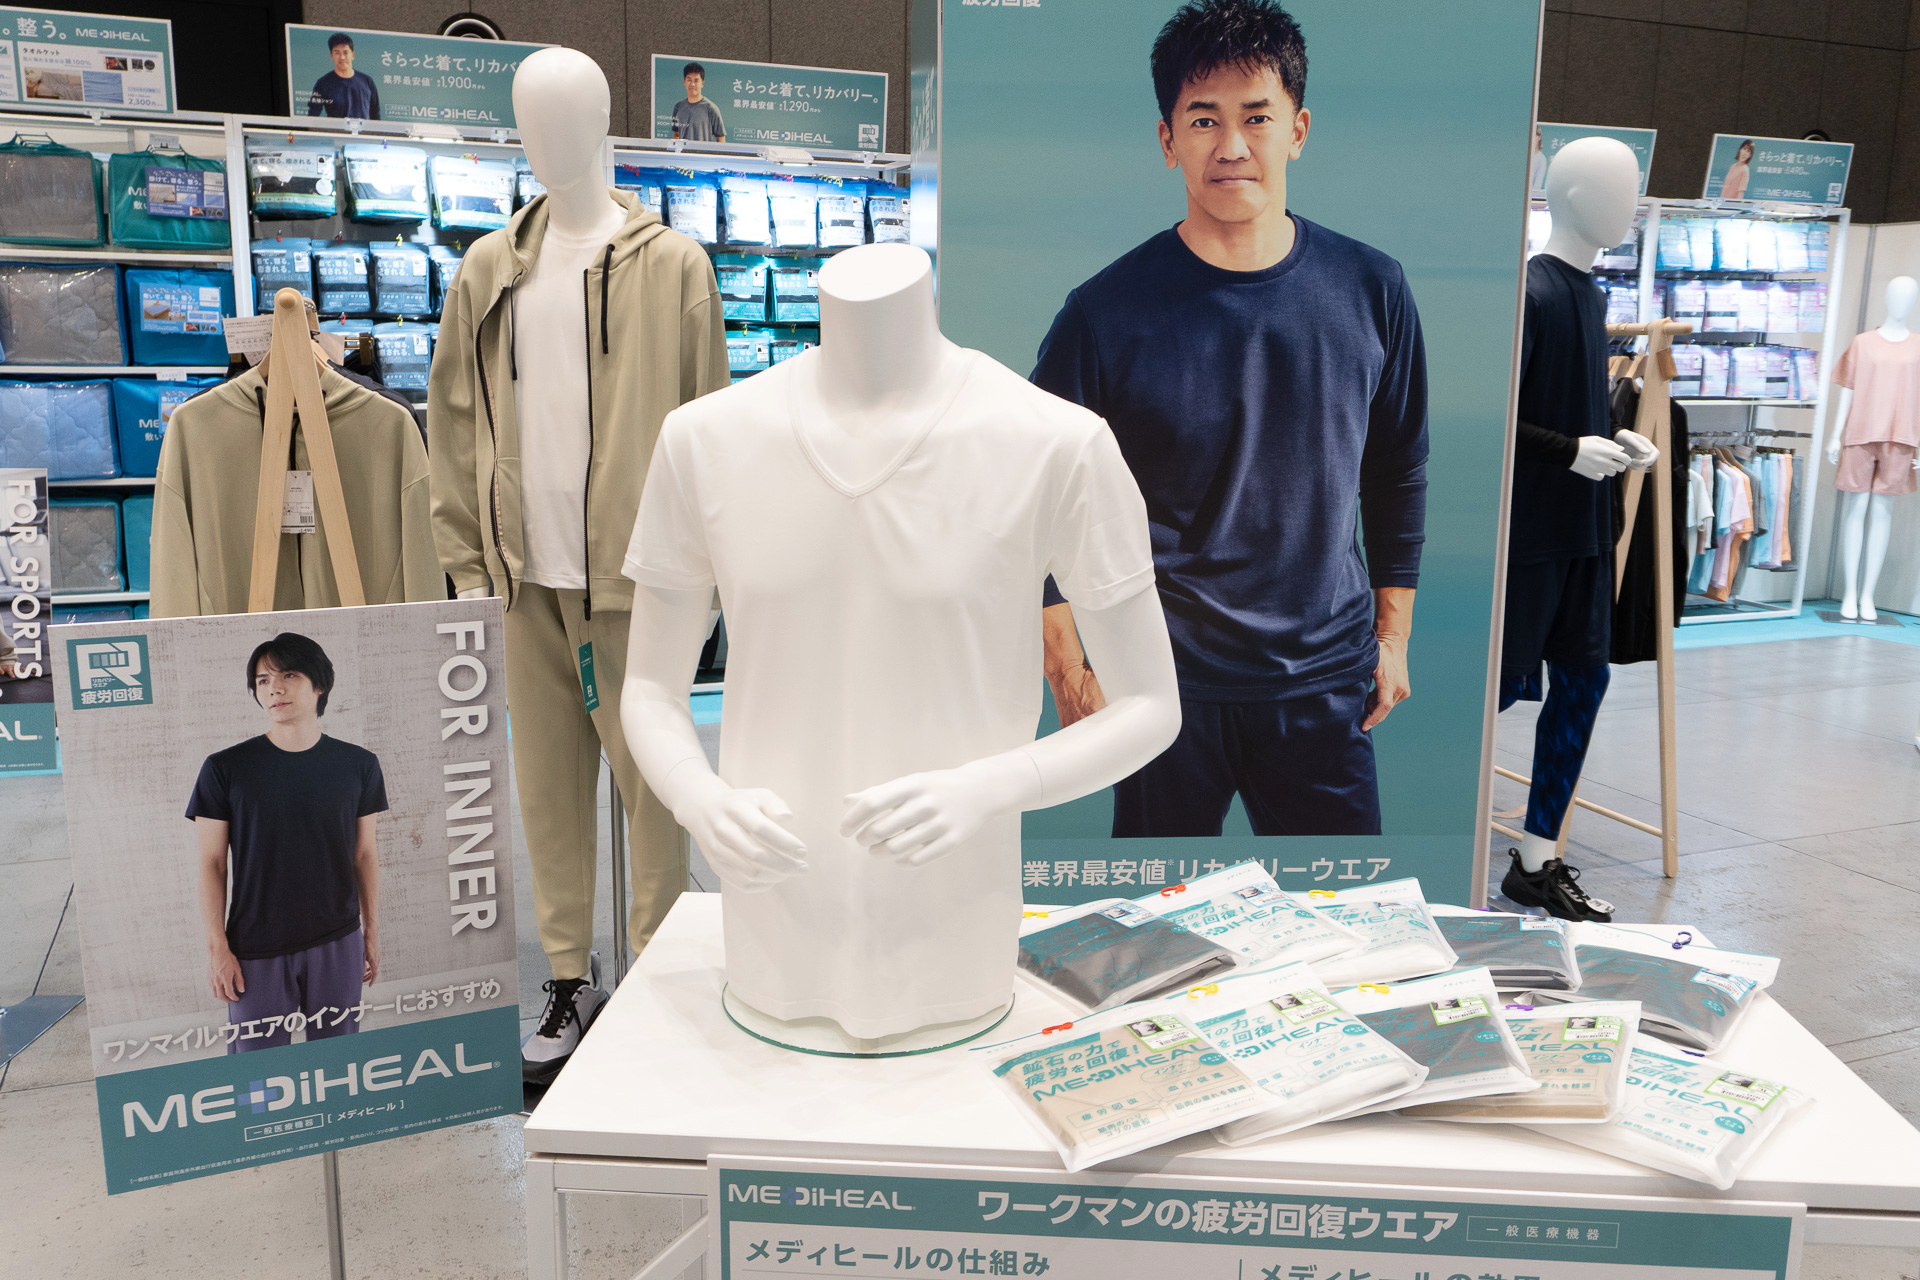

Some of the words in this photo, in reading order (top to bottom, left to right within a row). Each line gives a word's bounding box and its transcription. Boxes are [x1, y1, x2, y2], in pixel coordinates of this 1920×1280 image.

[381, 50, 520, 74] さらっと着て、リカバ
[732, 78, 879, 104] さらっと着て、リカバリー。
[8, 479, 39, 546] FOR
[10, 556, 43, 680] SPORTS
[81, 687, 144, 705] 疲労回復
[436, 620, 489, 741] FOR
[443, 759, 498, 937] INNER
[1178, 857, 1391, 882] リカリーウエア
[102, 977, 501, 1063] ワンマイルウエアのインナーにおすすめ
[1022, 1039, 1122, 1076] 鉱石の力で
[253, 1118, 315, 1136] 一般医療機器
[977, 1190, 1459, 1243] ワークマンの疲労回復ウエア
[1485, 1223, 1601, 1242] 一般医療機器
[745, 1238, 1051, 1277] メディヒールの仕組み
